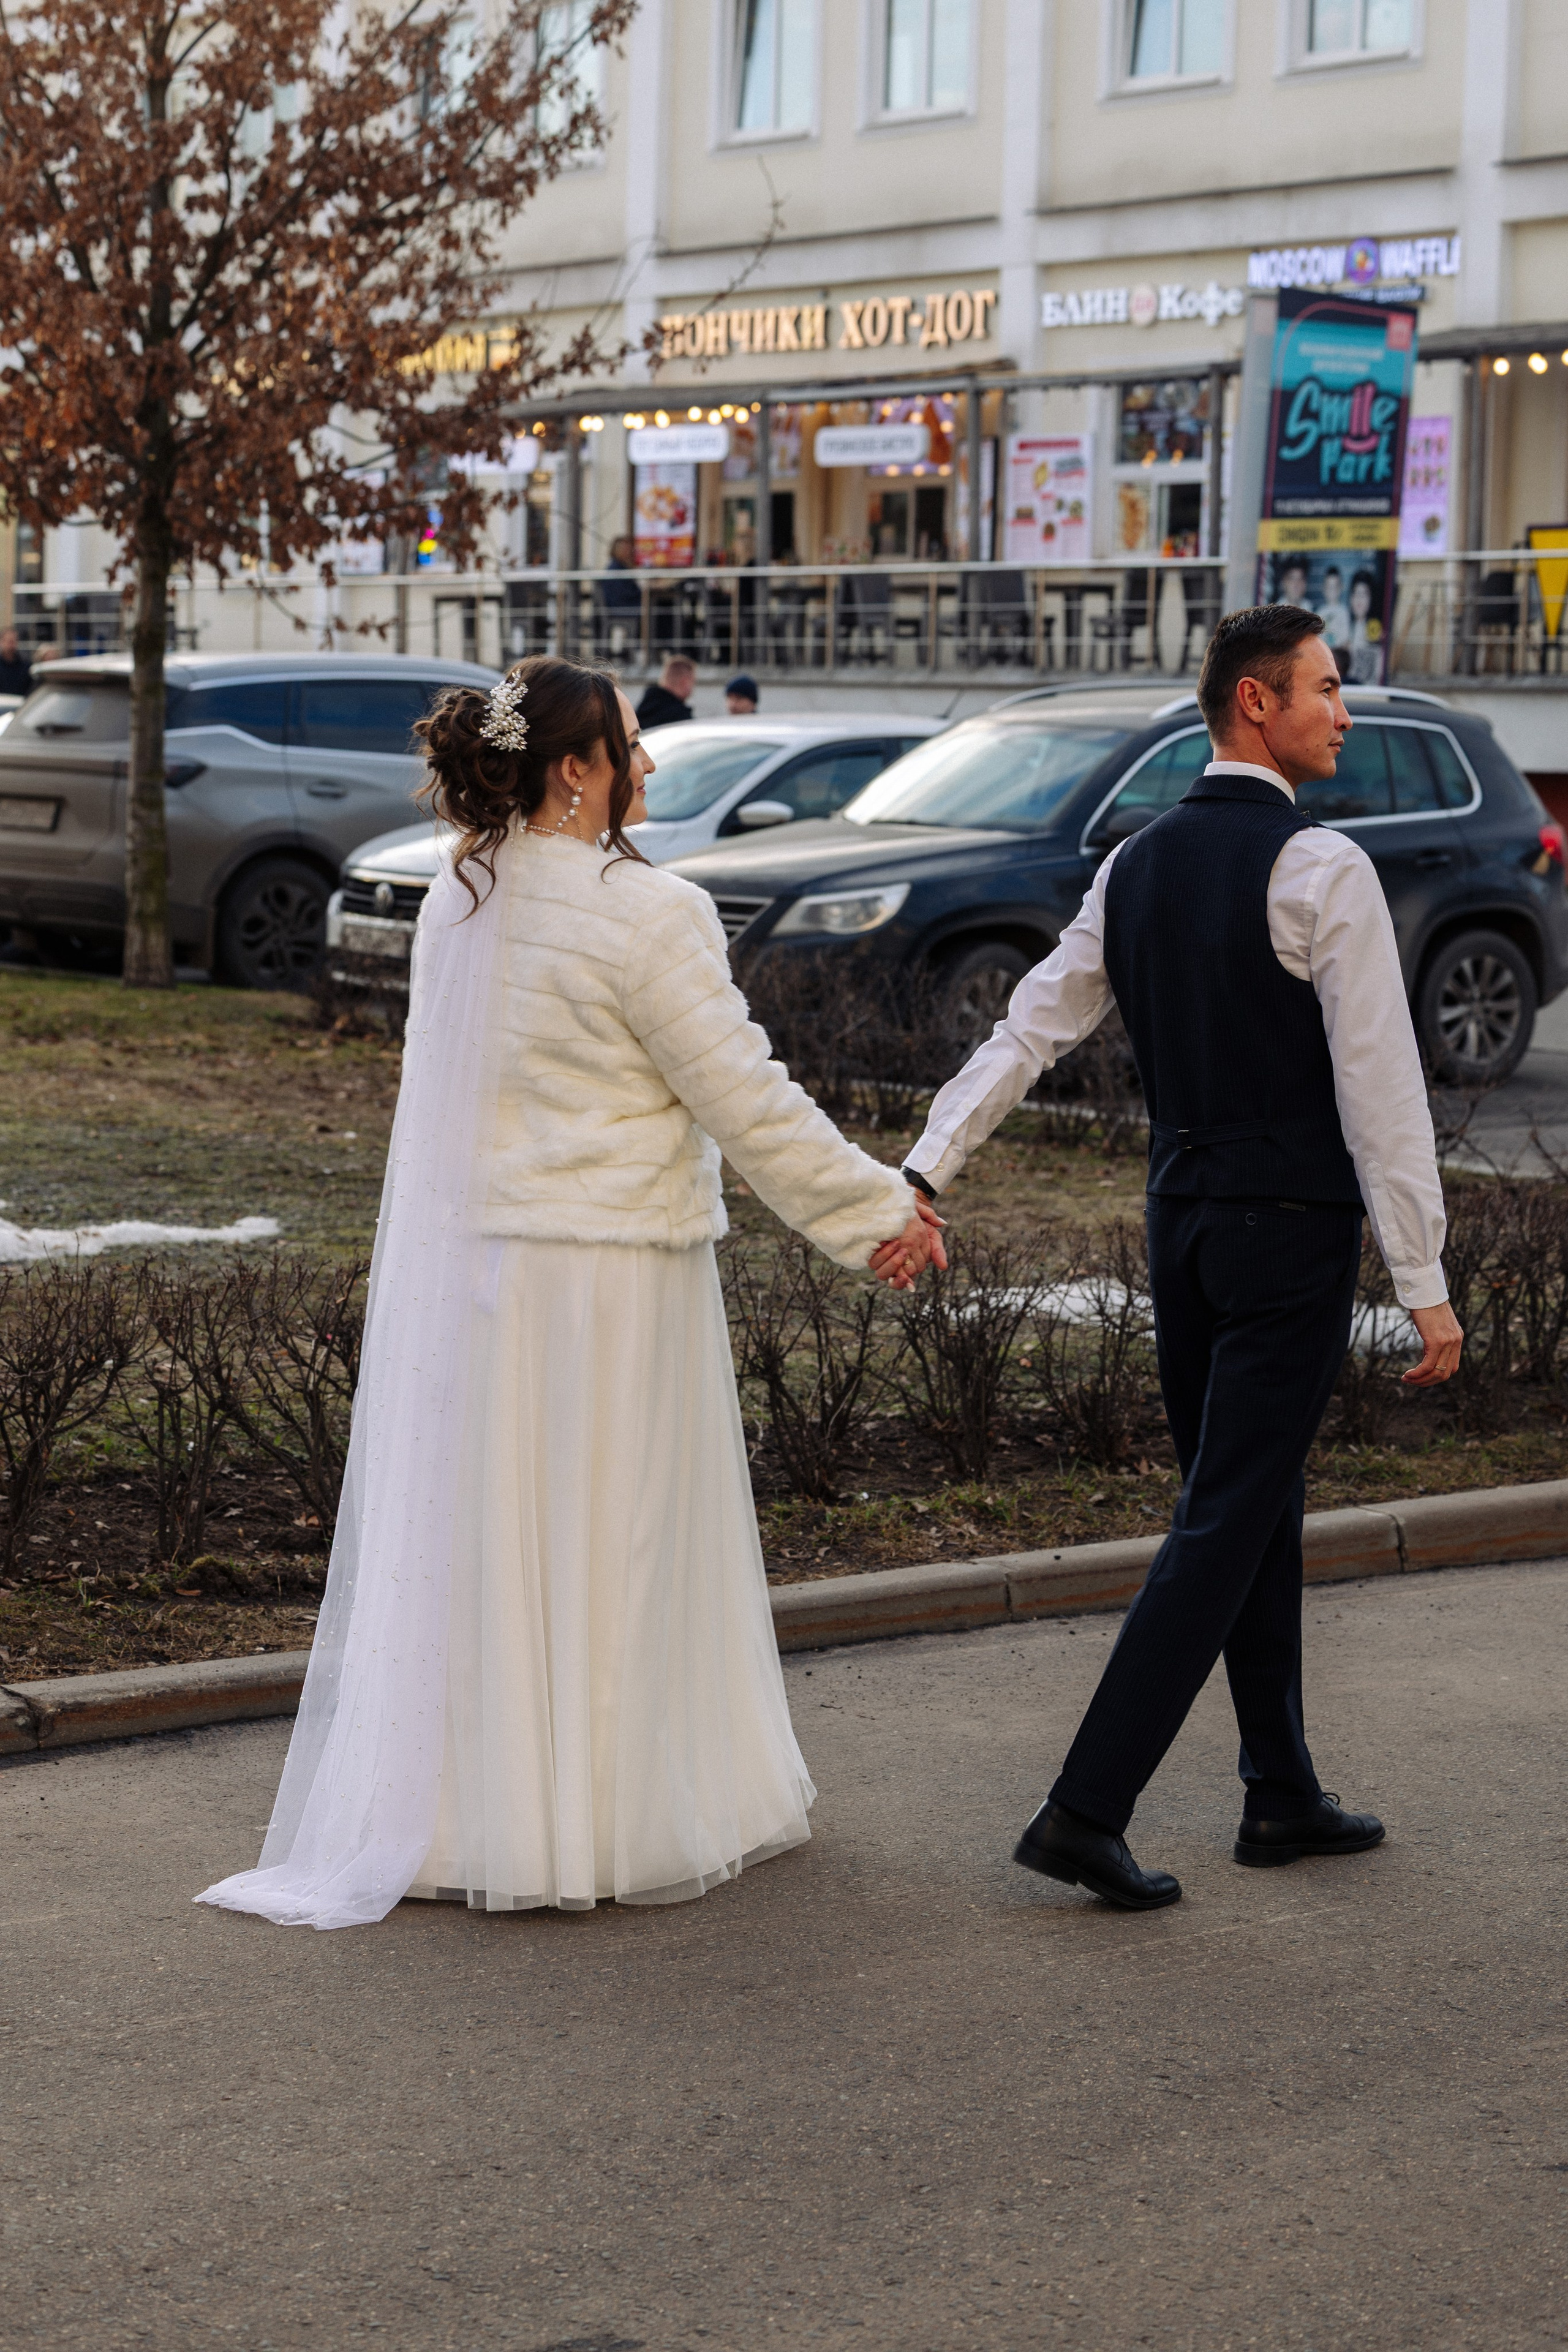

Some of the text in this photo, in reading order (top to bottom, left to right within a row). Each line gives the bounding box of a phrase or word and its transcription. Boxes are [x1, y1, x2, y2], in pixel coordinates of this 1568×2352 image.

[1247, 246, 1346, 288] MOSCOW
[1159, 281, 1243, 326] Кофе
[1279, 379, 1399, 461] Smile
[1319, 431, 1392, 485] Park
